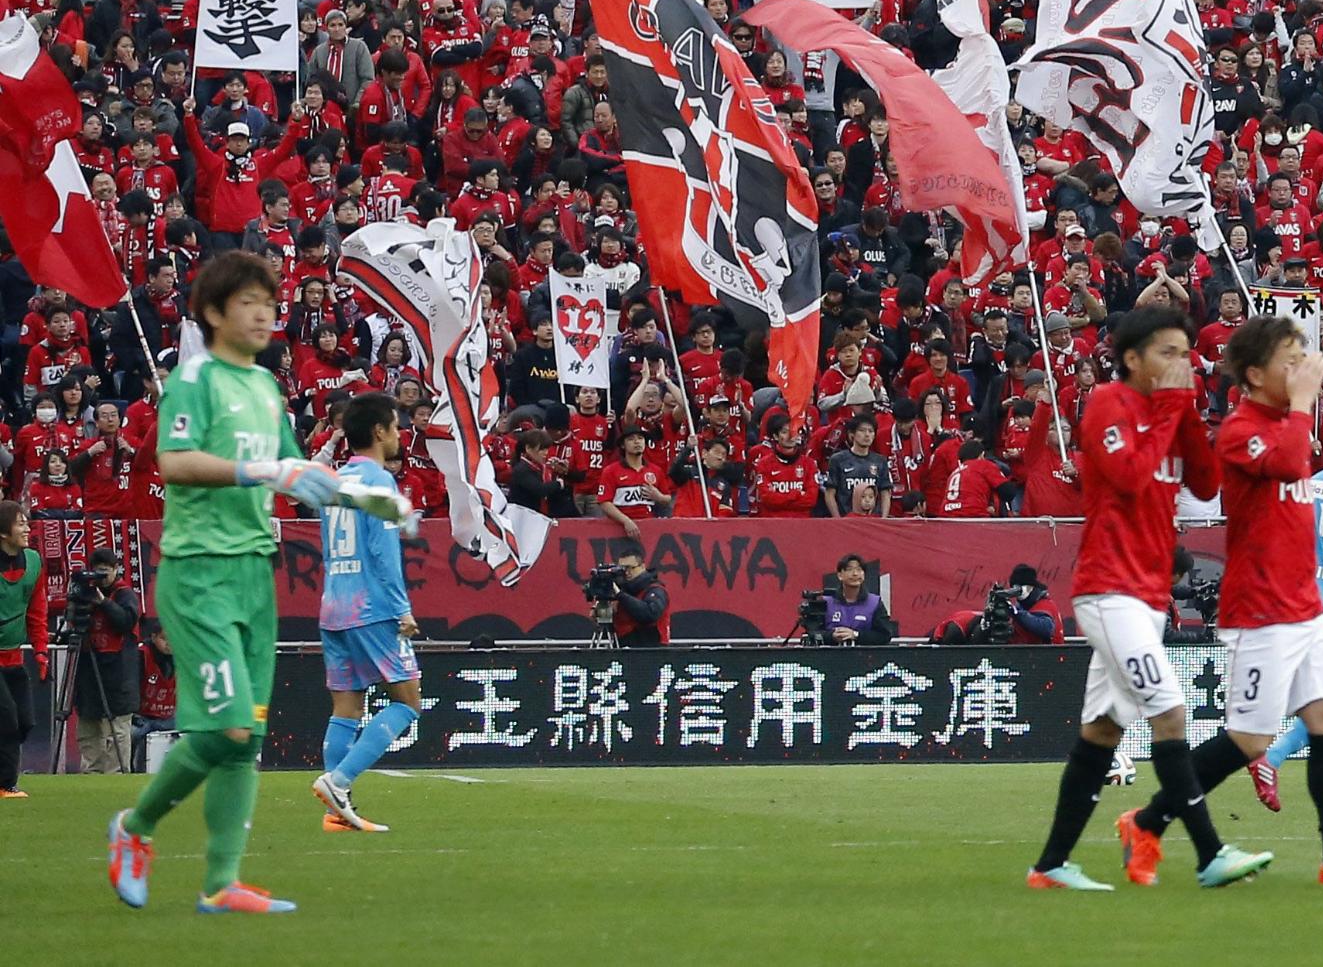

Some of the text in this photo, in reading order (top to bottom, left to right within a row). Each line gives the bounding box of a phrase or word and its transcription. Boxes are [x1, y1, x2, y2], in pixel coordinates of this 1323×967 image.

[562, 308, 603, 335] 12
[200, 660, 234, 701] 21
[1126, 653, 1162, 690] 30
[1244, 668, 1262, 702] 3
